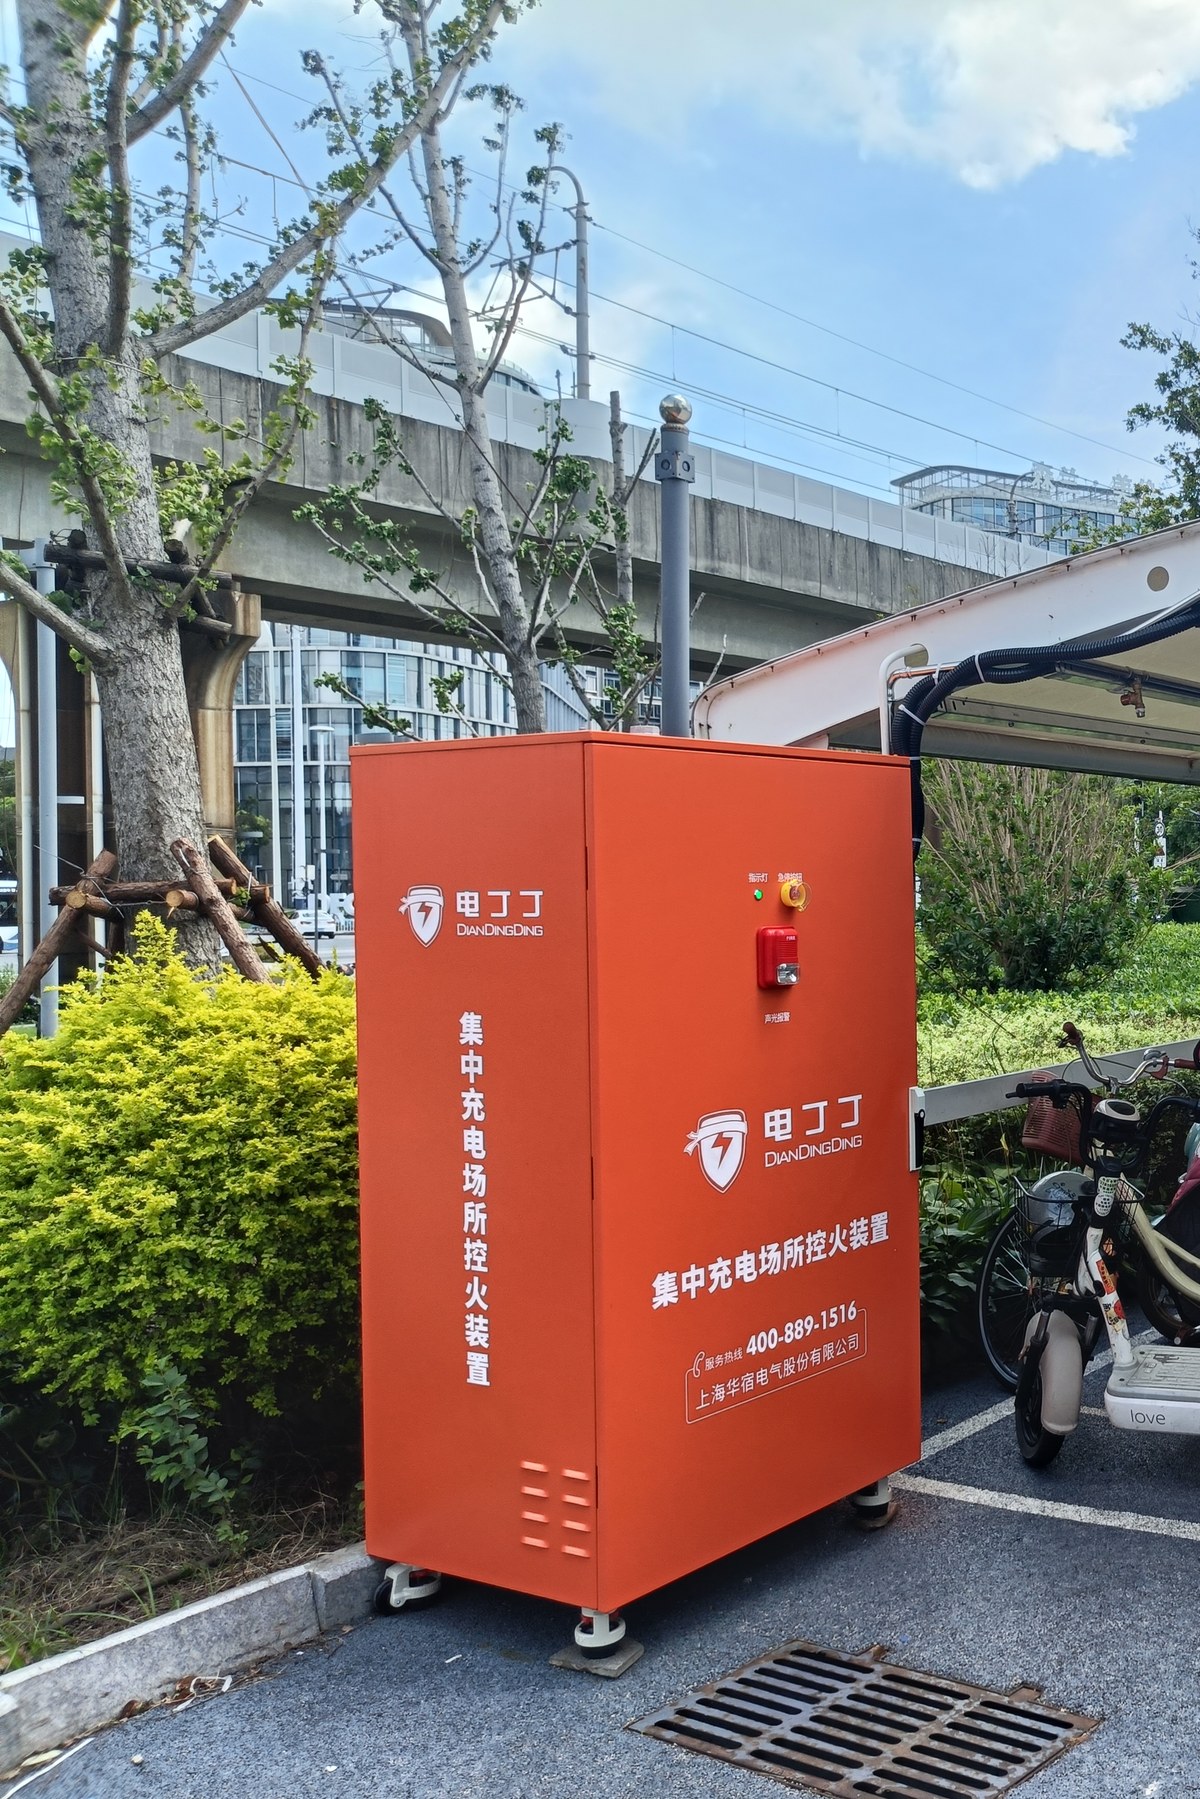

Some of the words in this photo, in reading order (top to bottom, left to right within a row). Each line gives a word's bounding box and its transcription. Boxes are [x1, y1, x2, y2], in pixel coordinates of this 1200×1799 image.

[748, 872, 768, 883] 指示灯
[456, 890, 544, 918] 电丁丁
[764, 1011, 791, 1024] 声光报警
[764, 1094, 862, 1141] 电丁丁
[459, 1011, 491, 1387] 集中充电场所控火装置
[652, 1211, 889, 1310] 集中充电场所控火装置
[704, 1347, 744, 1371] 服务热线
[746, 1300, 857, 1356] 400-889-1516
[695, 1333, 860, 1411] 上海华宿电气股份有限公司
[1130, 1409, 1166, 1425] love
